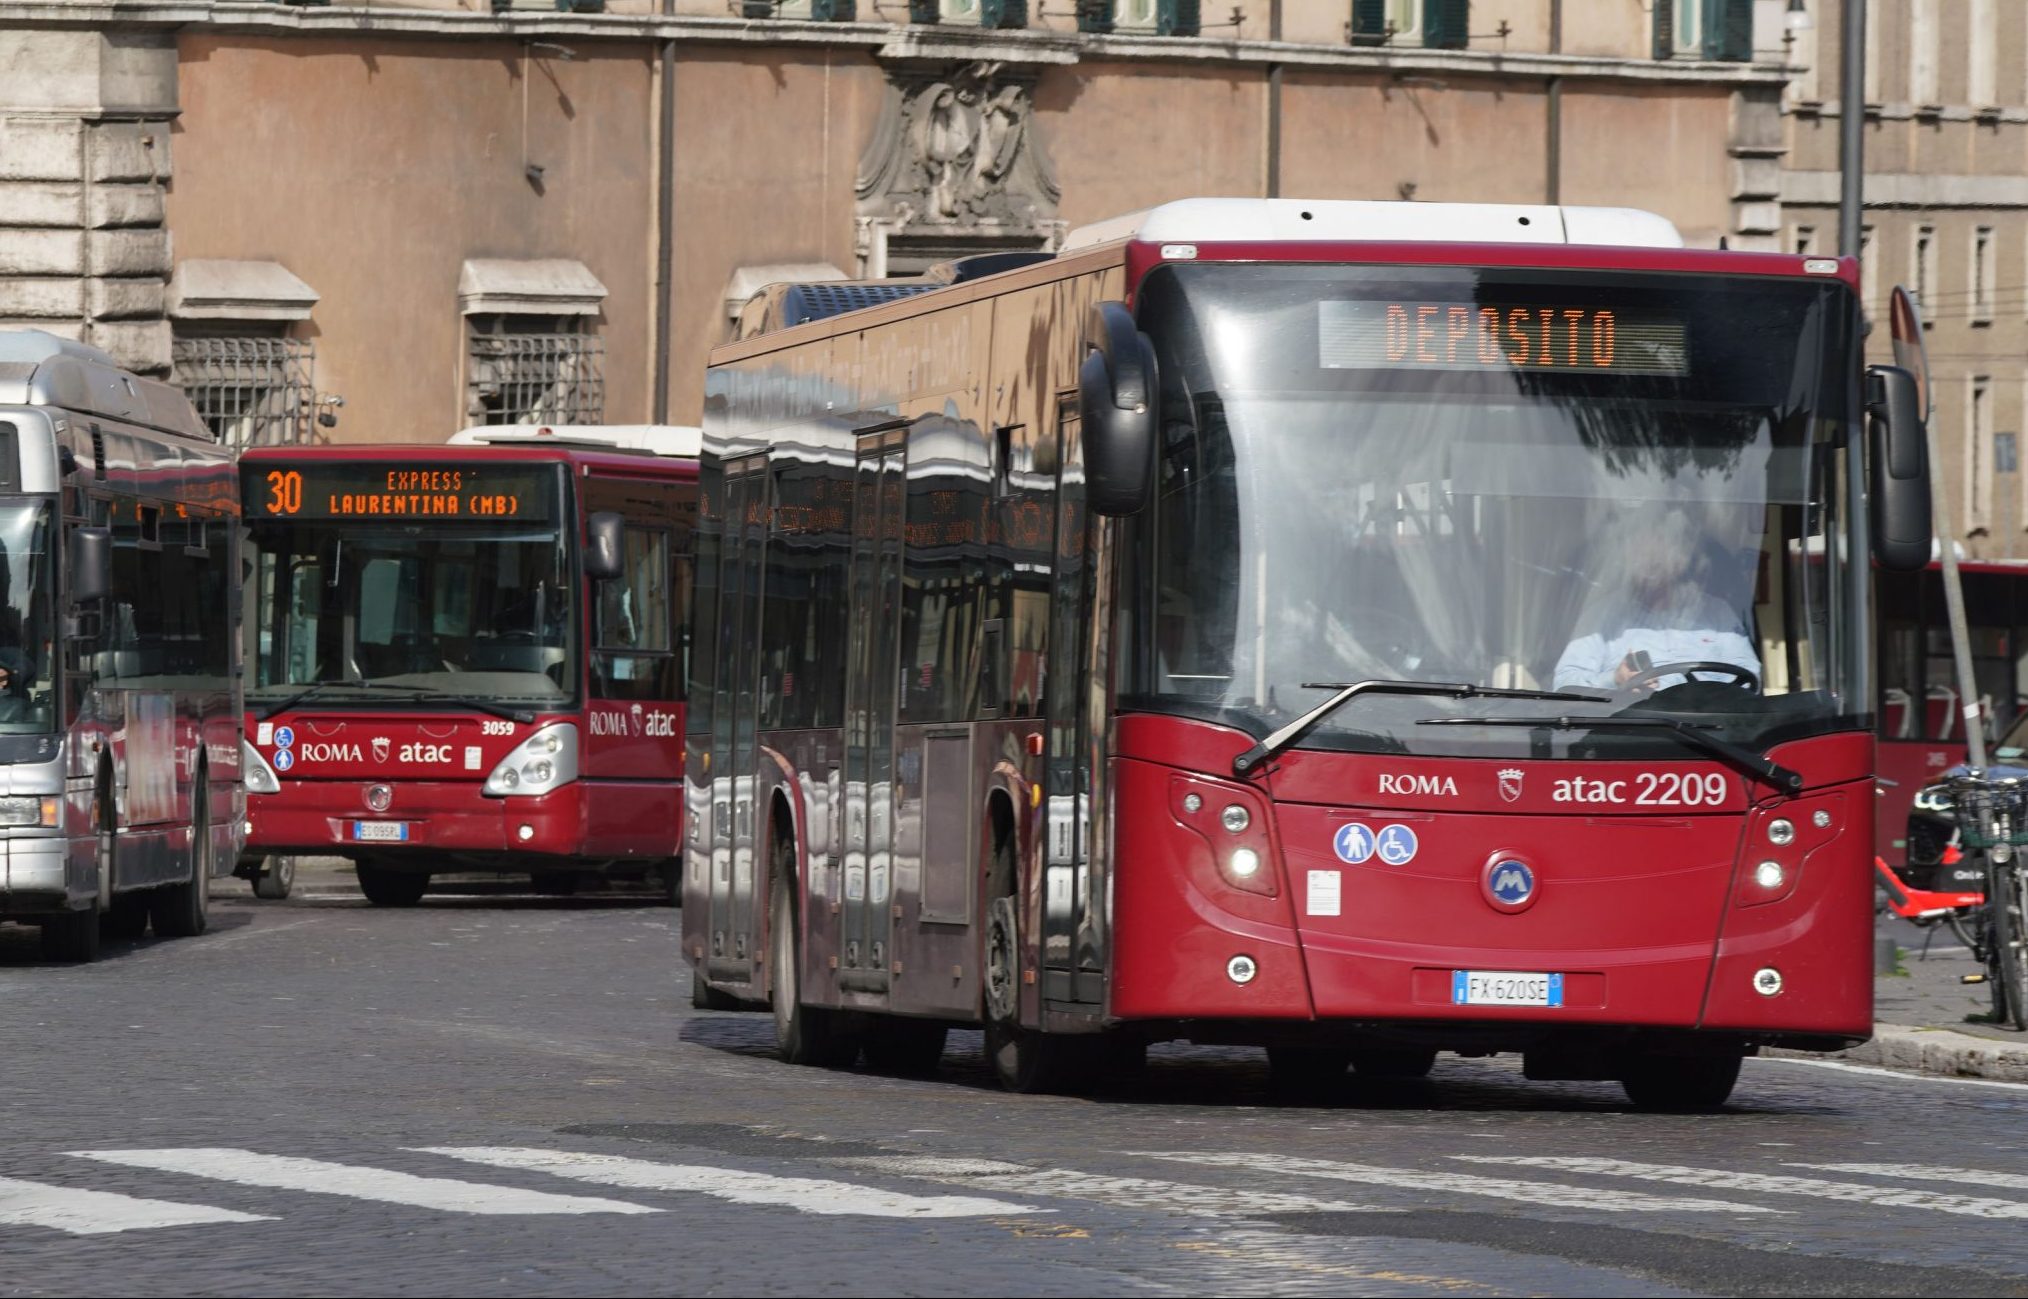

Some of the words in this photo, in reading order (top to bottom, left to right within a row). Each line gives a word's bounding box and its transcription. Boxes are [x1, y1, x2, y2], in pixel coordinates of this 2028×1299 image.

[1386, 304, 1615, 367] DEPOSITO
[266, 470, 302, 513] 30
[387, 471, 462, 491] EXPRESS
[329, 495, 459, 514] LAURENTINA
[469, 495, 518, 514] (MB)
[482, 721, 515, 735] 3059
[589, 711, 628, 736] ROMA
[645, 709, 676, 736] atac
[301, 743, 364, 762] ROMA
[399, 742, 452, 763] atac
[1378, 774, 1459, 796] ROMA
[1552, 776, 1626, 803] atac
[1635, 773, 1727, 805] 2209
